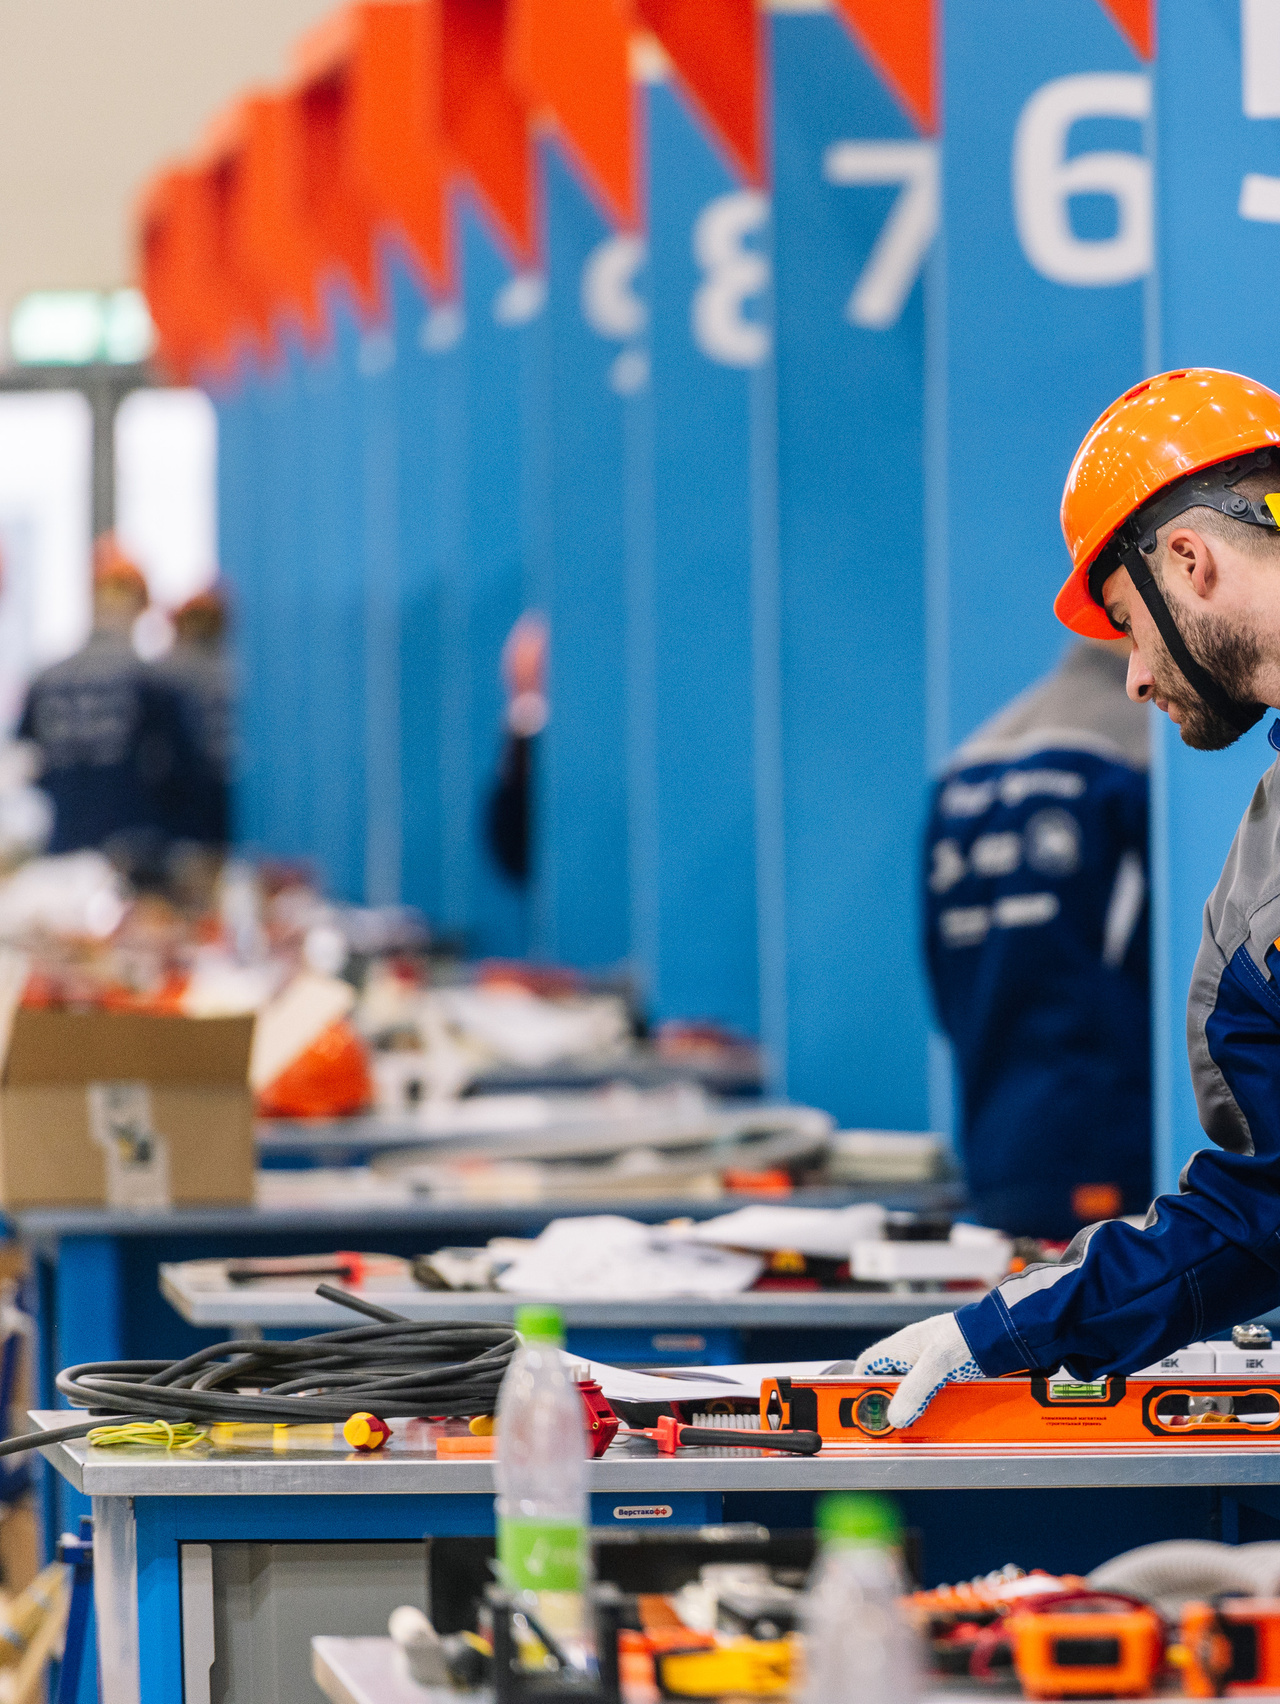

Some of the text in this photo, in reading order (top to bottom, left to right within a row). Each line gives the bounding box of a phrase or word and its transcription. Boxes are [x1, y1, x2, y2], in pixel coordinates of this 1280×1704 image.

[821, 138, 941, 331] 7
[1010, 71, 1157, 288] 6
[618, 1508, 667, 1516] Верстакофф
